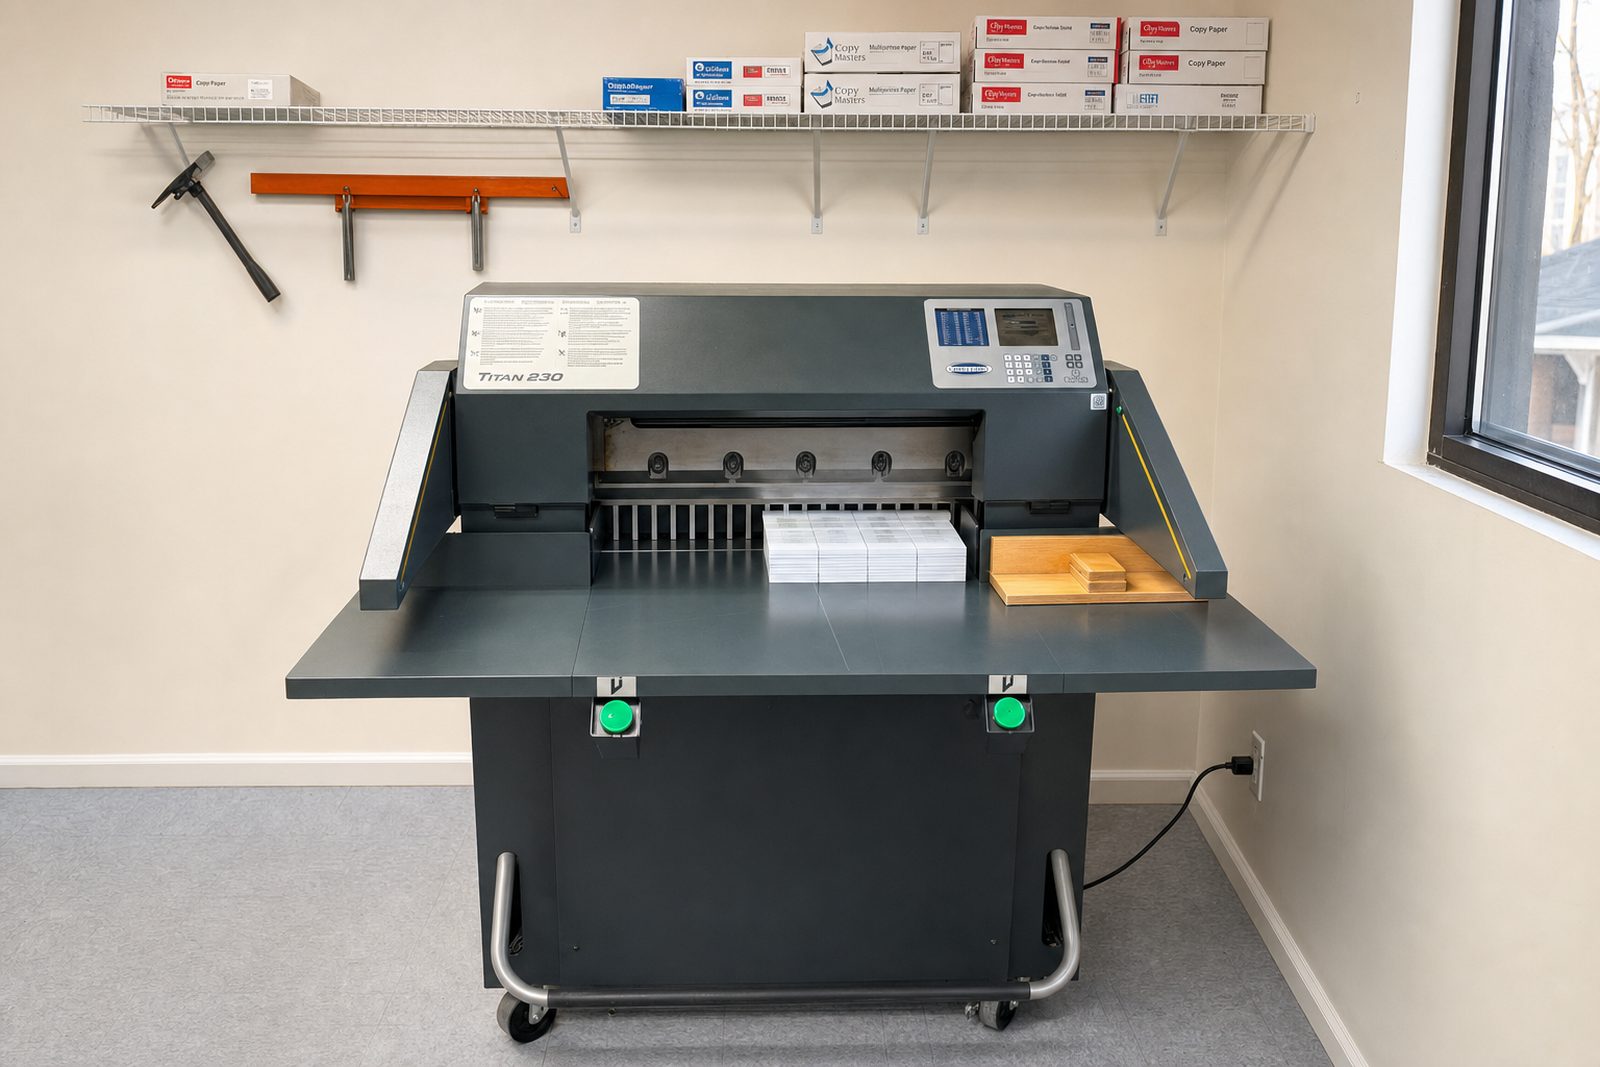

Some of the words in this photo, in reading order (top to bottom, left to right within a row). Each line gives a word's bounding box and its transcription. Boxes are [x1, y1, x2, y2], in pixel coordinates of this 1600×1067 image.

[1189, 25, 1208, 34] Copy
[1208, 25, 1228, 34] Paper
[834, 43, 860, 54] Copy
[834, 54, 866, 62] Masters
[1188, 60, 1206, 68] Copy
[1206, 60, 1226, 68] Paper
[834, 86, 859, 97] Copy
[900, 86, 917, 95] Paper
[526, 372, 564, 382] 230
